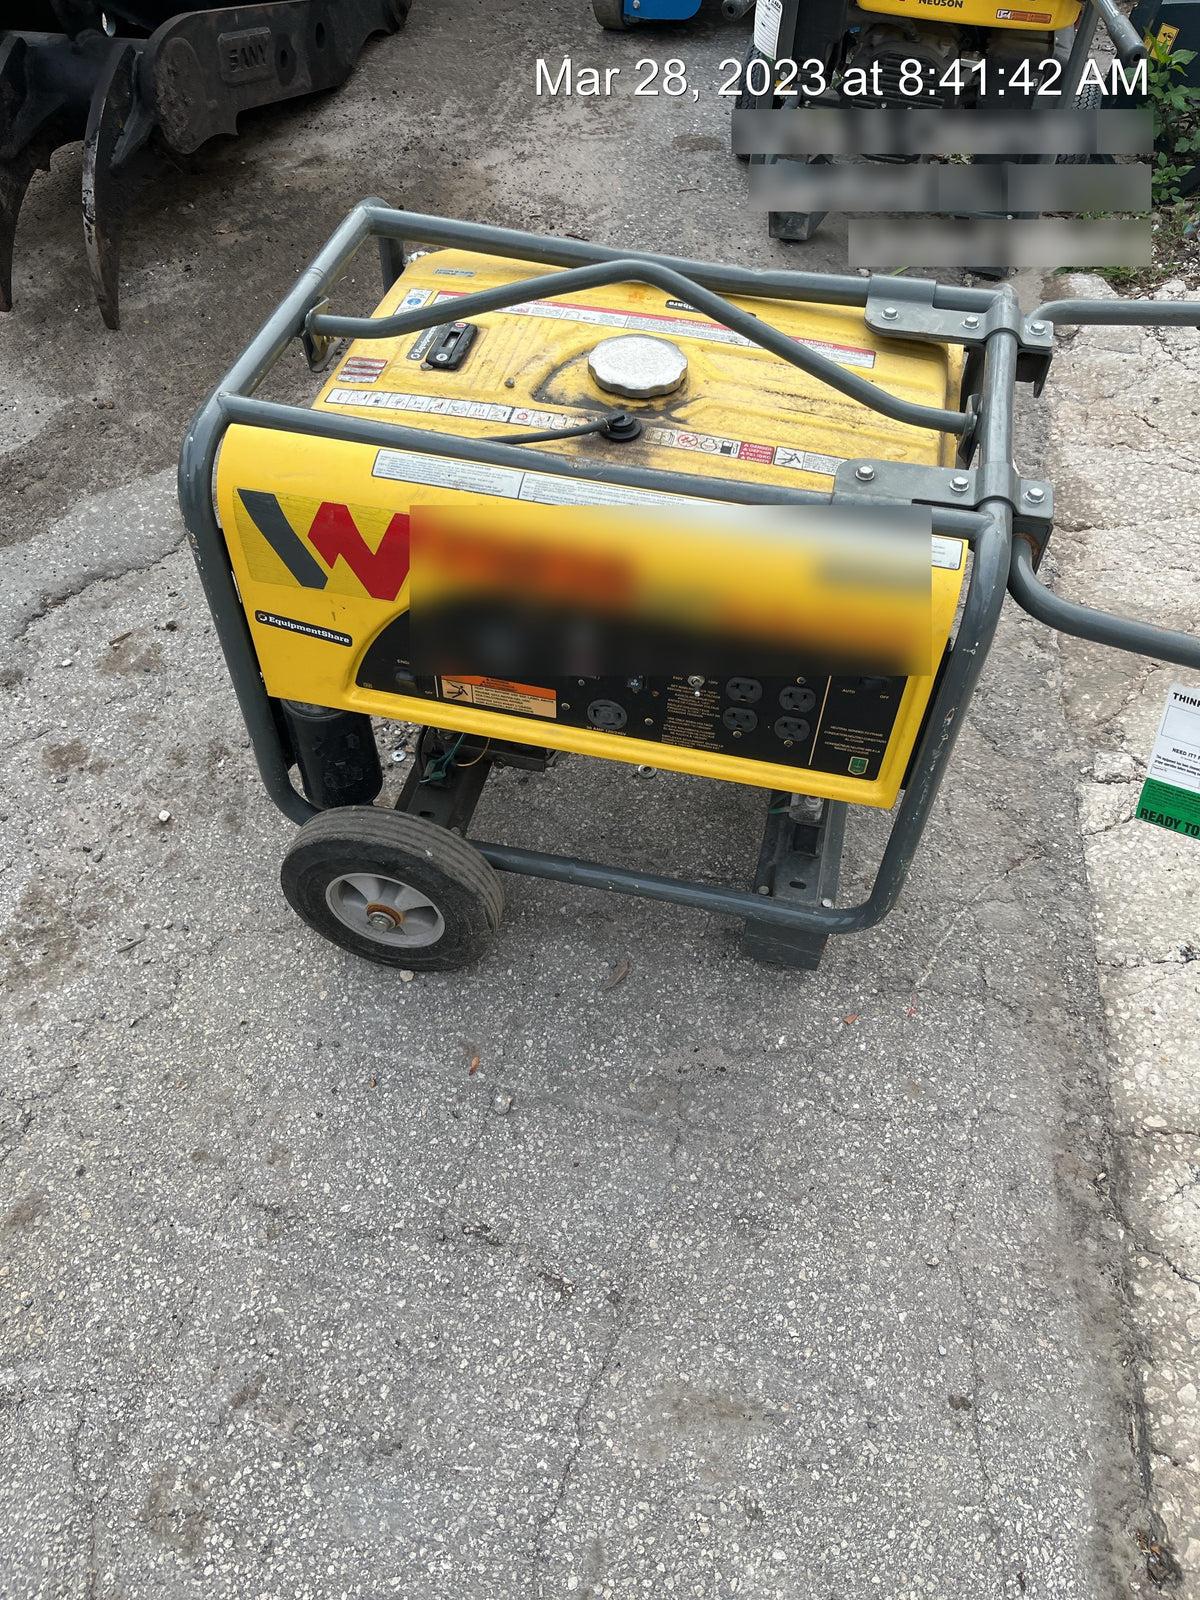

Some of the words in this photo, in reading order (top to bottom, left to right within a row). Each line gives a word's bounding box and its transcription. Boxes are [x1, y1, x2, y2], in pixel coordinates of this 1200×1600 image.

[268, 616, 350, 645] EquipmentShare
[1172, 747, 1188, 757] NEED
[1139, 808, 1182, 830] READY
